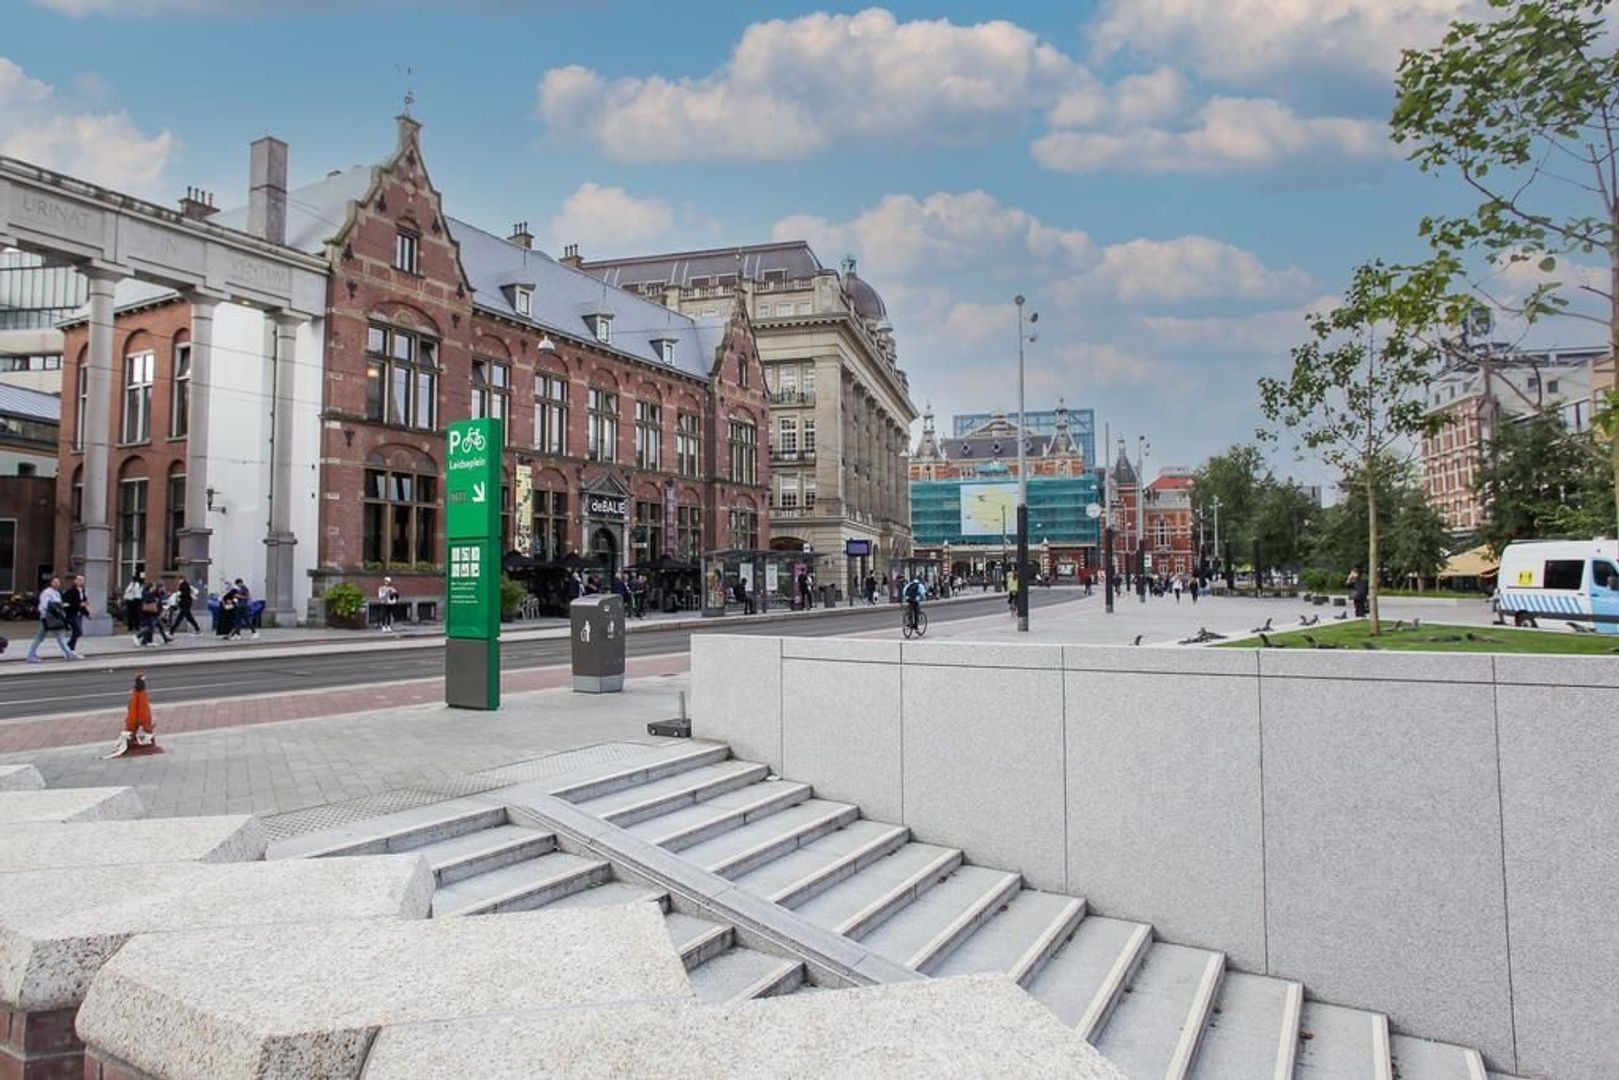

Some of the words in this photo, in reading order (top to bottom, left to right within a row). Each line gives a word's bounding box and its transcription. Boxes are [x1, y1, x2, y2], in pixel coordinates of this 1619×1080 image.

[22, 194, 91, 229] URINAT
[160, 237, 177, 254] IN
[450, 431, 461, 455] P
[449, 457, 486, 470] Leidseplein
